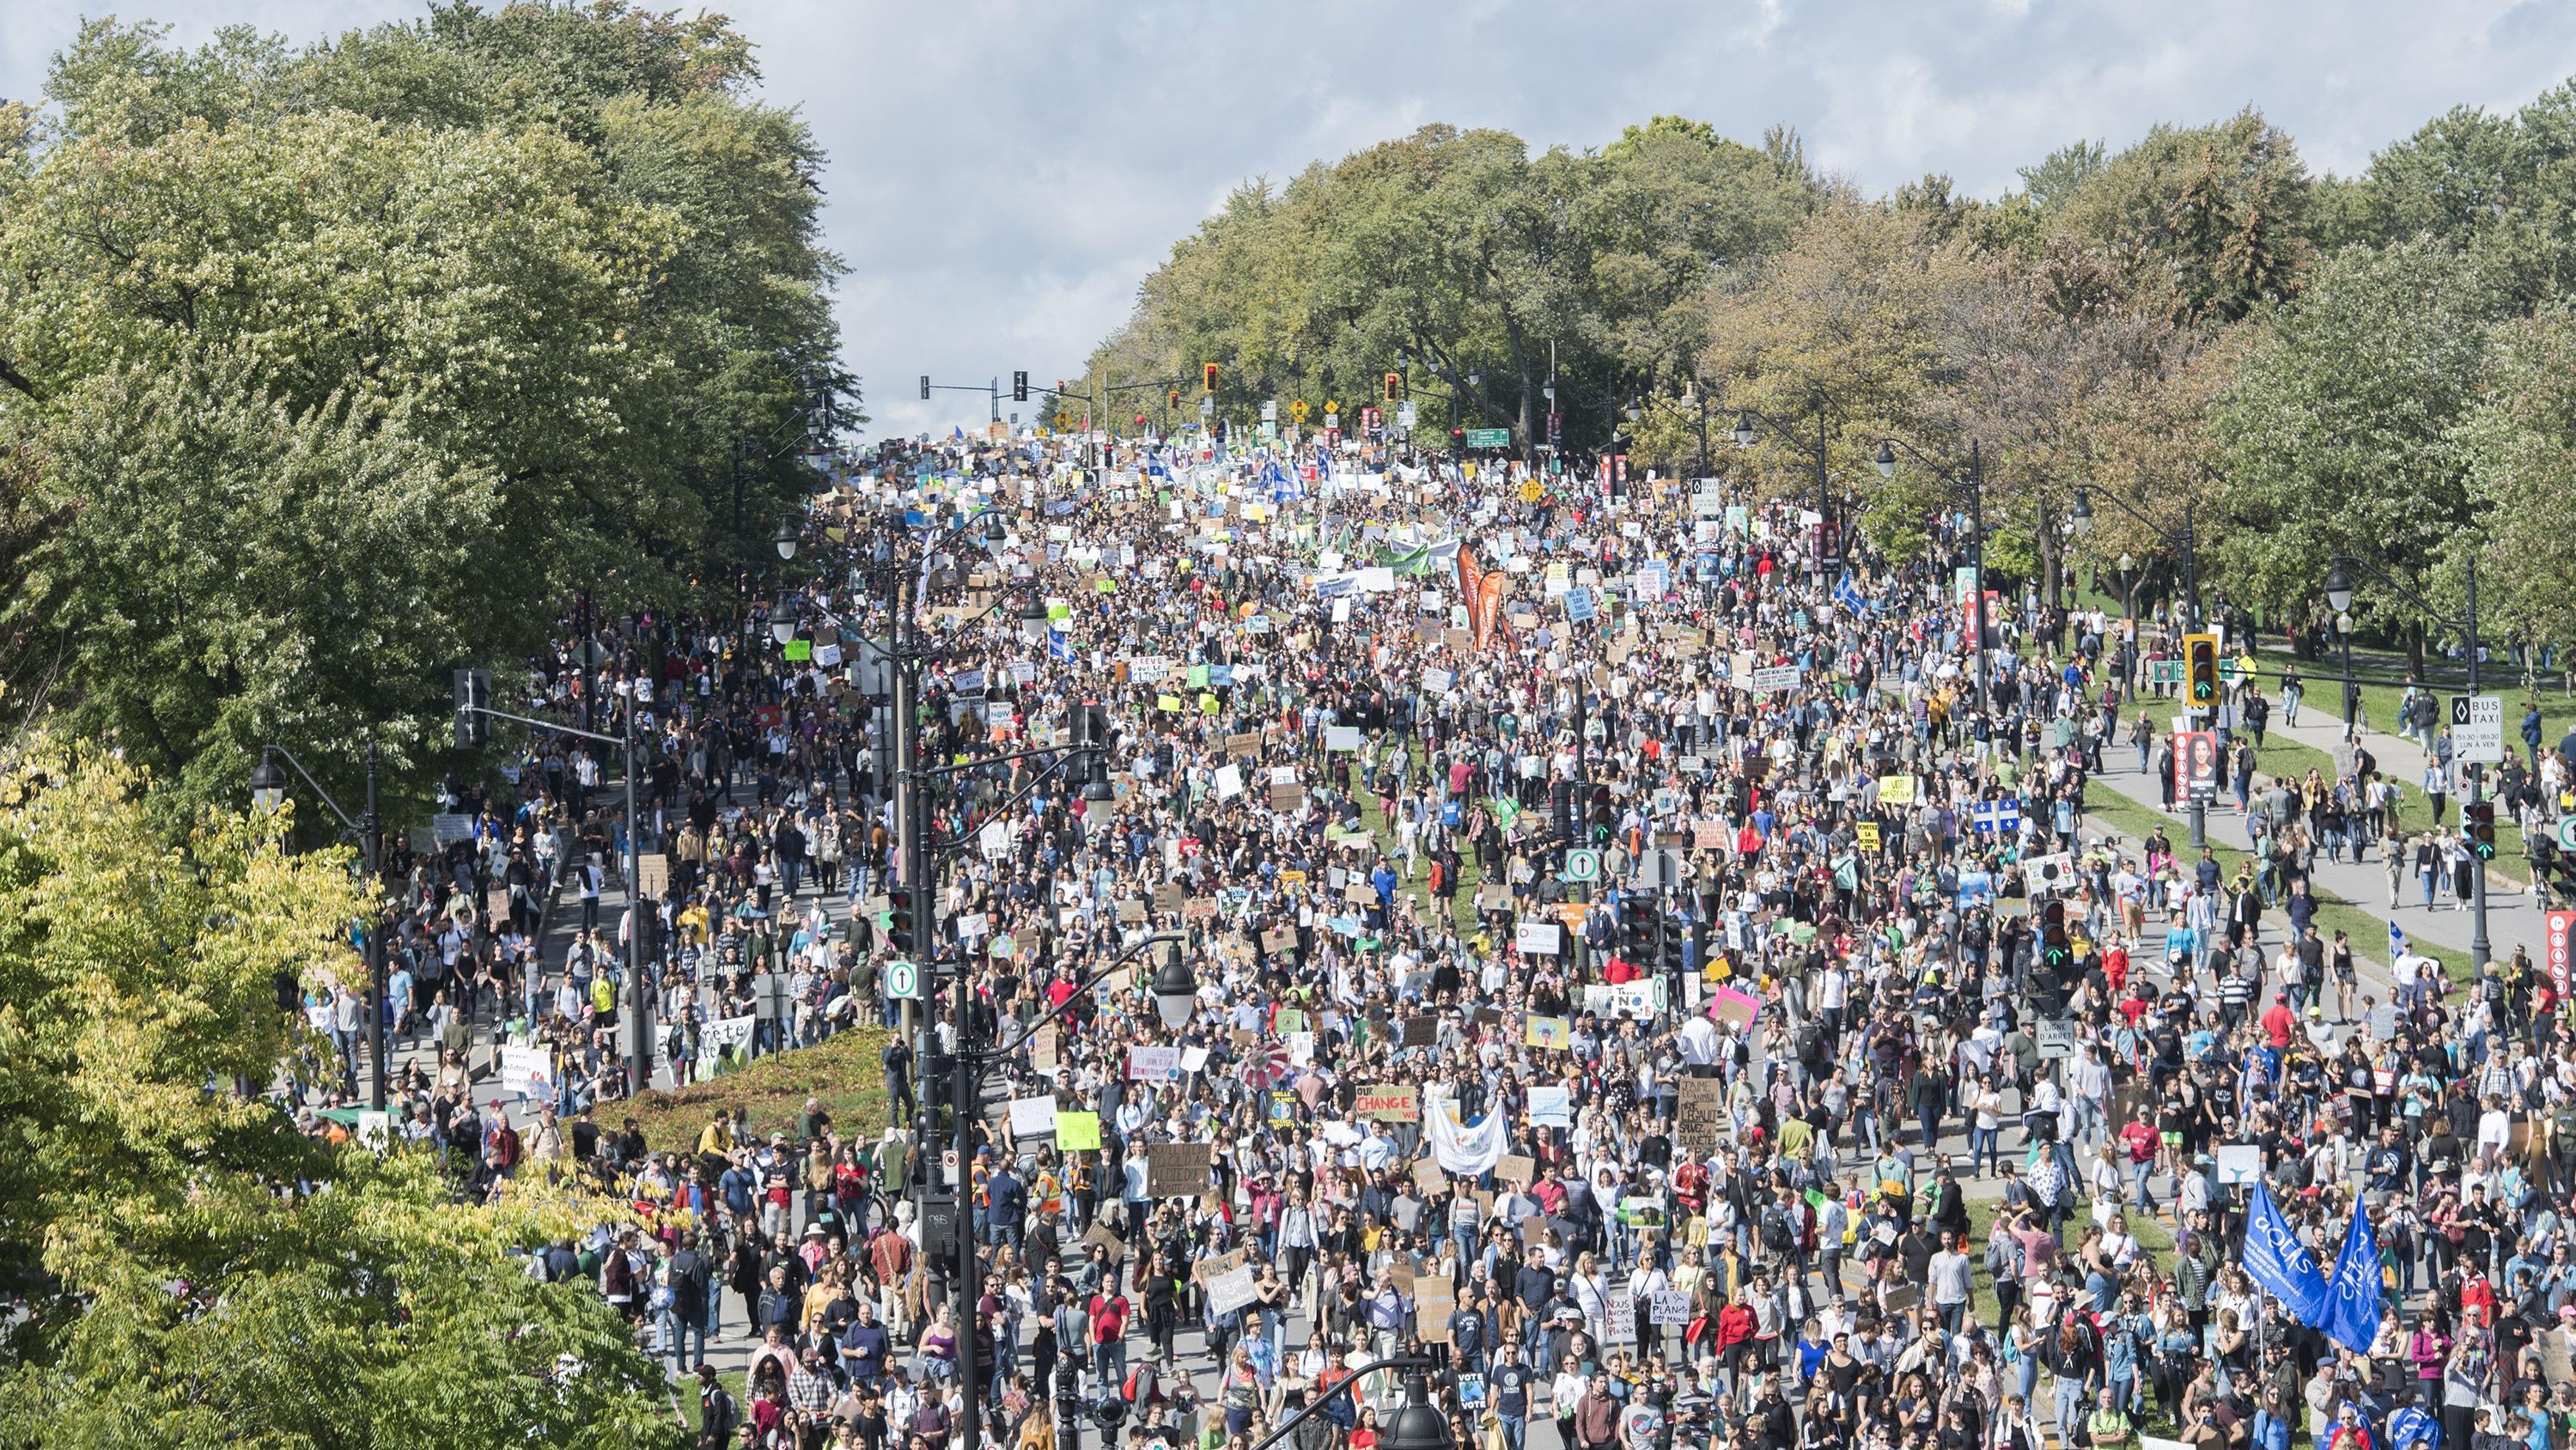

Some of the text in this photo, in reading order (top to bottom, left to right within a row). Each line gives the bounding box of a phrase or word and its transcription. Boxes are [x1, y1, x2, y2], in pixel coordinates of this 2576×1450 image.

[1572, 610, 1592, 619] COMING
[969, 698, 985, 707] BEES
[2472, 701, 2499, 711] BUS
[2473, 714, 2500, 724] TAXI
[2061, 862, 2072, 874] B
[1617, 987, 1636, 996] There
[1645, 1005, 1651, 1017] B
[2044, 1023, 2066, 1032] LIGNE
[1357, 1087, 1373, 1096] OUR
[1683, 1081, 1710, 1092] J'AIME
[1357, 1097, 1411, 1111] CHANGE
[1682, 1109, 1717, 1123] LEGAULT
[1679, 1123, 1703, 1134] SAUVEZ
[1703, 1128, 1711, 1136] LA
[1150, 1144, 1178, 1155] YOU'LL
[1149, 1155, 1211, 1167] TO OLD AGE
[1210, 1270, 1252, 1296] Project
[1212, 1289, 1255, 1314] Drawdown
[1654, 1294, 1667, 1305] LA
[1458, 1373, 1484, 1381] VOTE
[1461, 1400, 1486, 1410] VOTE
